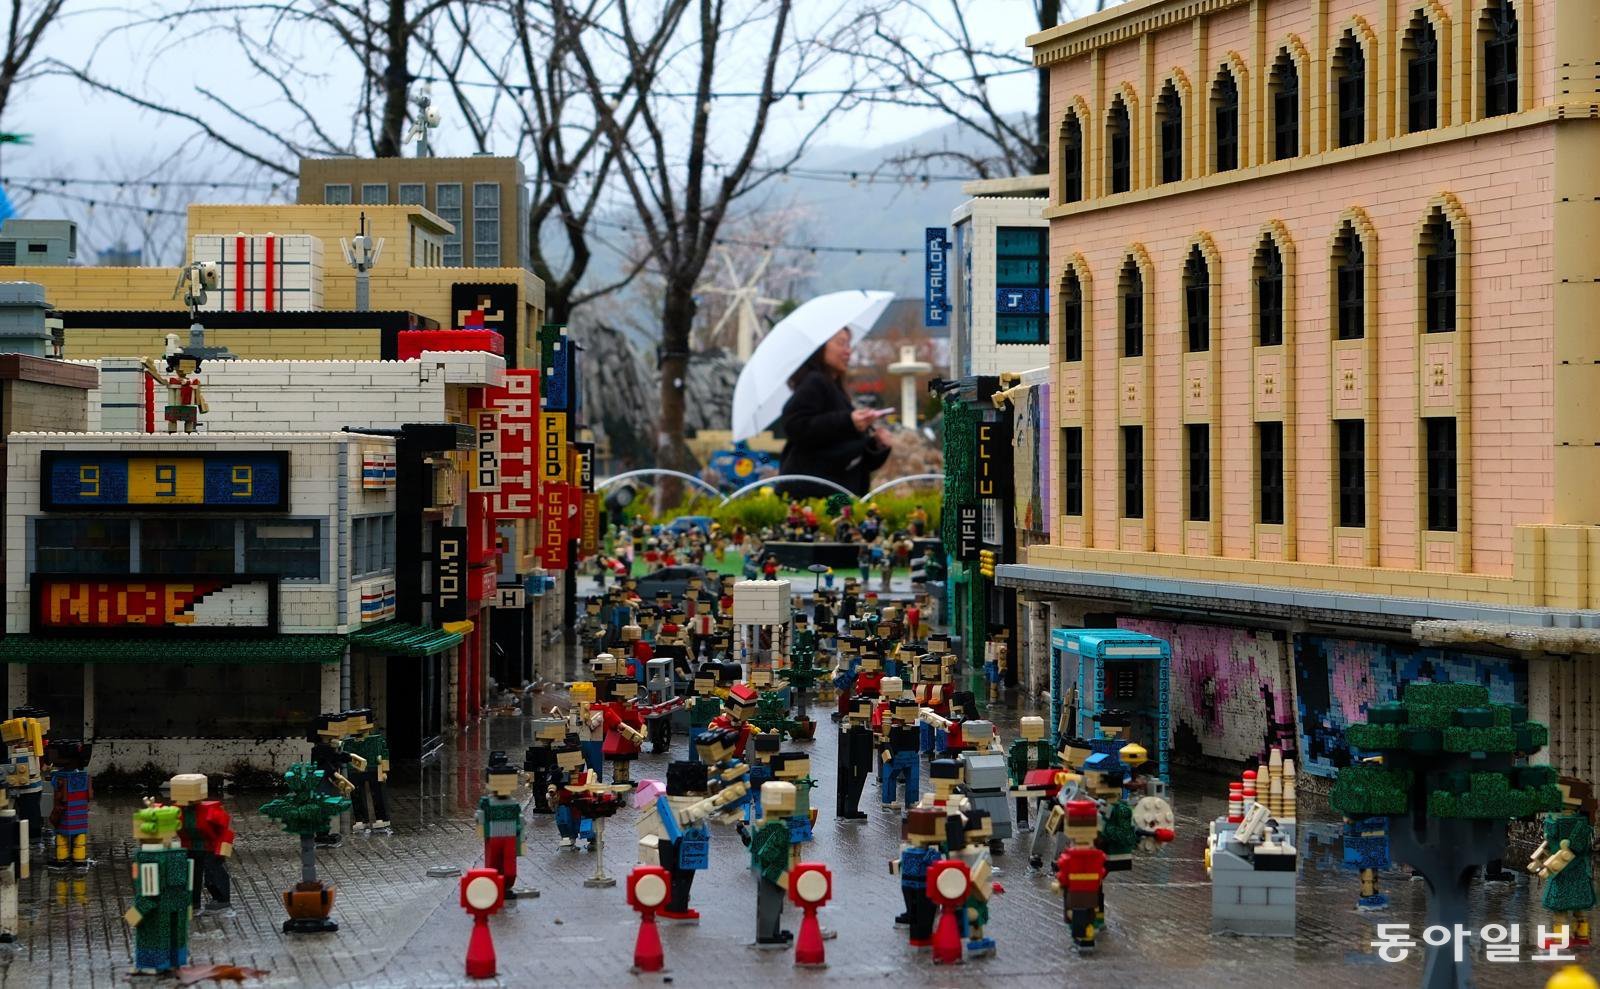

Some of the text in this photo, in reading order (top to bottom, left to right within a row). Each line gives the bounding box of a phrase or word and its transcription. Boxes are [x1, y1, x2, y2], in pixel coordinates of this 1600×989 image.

[493, 375, 532, 513] PRETTY
[546, 417, 562, 476] FOOD
[547, 491, 562, 562] KOREA
[502, 591, 516, 606] H
